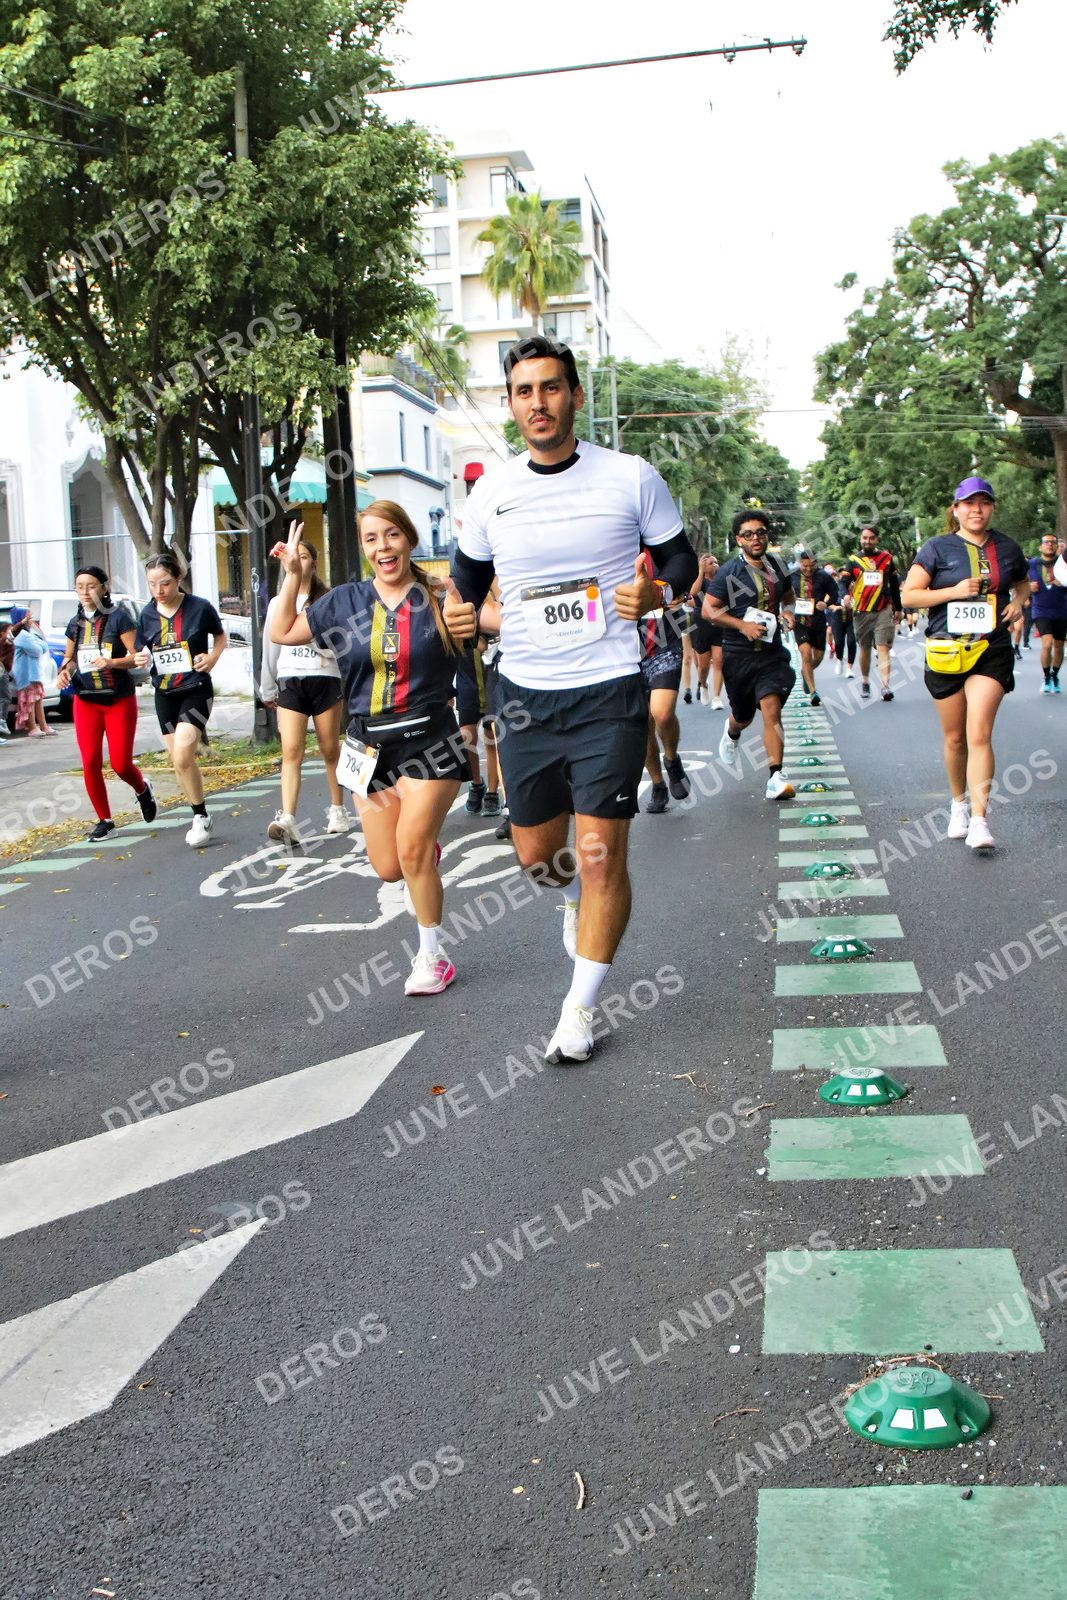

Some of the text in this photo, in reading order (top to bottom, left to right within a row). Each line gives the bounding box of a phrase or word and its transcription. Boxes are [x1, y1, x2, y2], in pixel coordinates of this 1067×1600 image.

[544, 600, 584, 625] 806
[954, 607, 986, 619] 2508
[159, 652, 183, 664] 5252
[291, 647, 317, 658] 4820
[345, 753, 364, 776] 784
